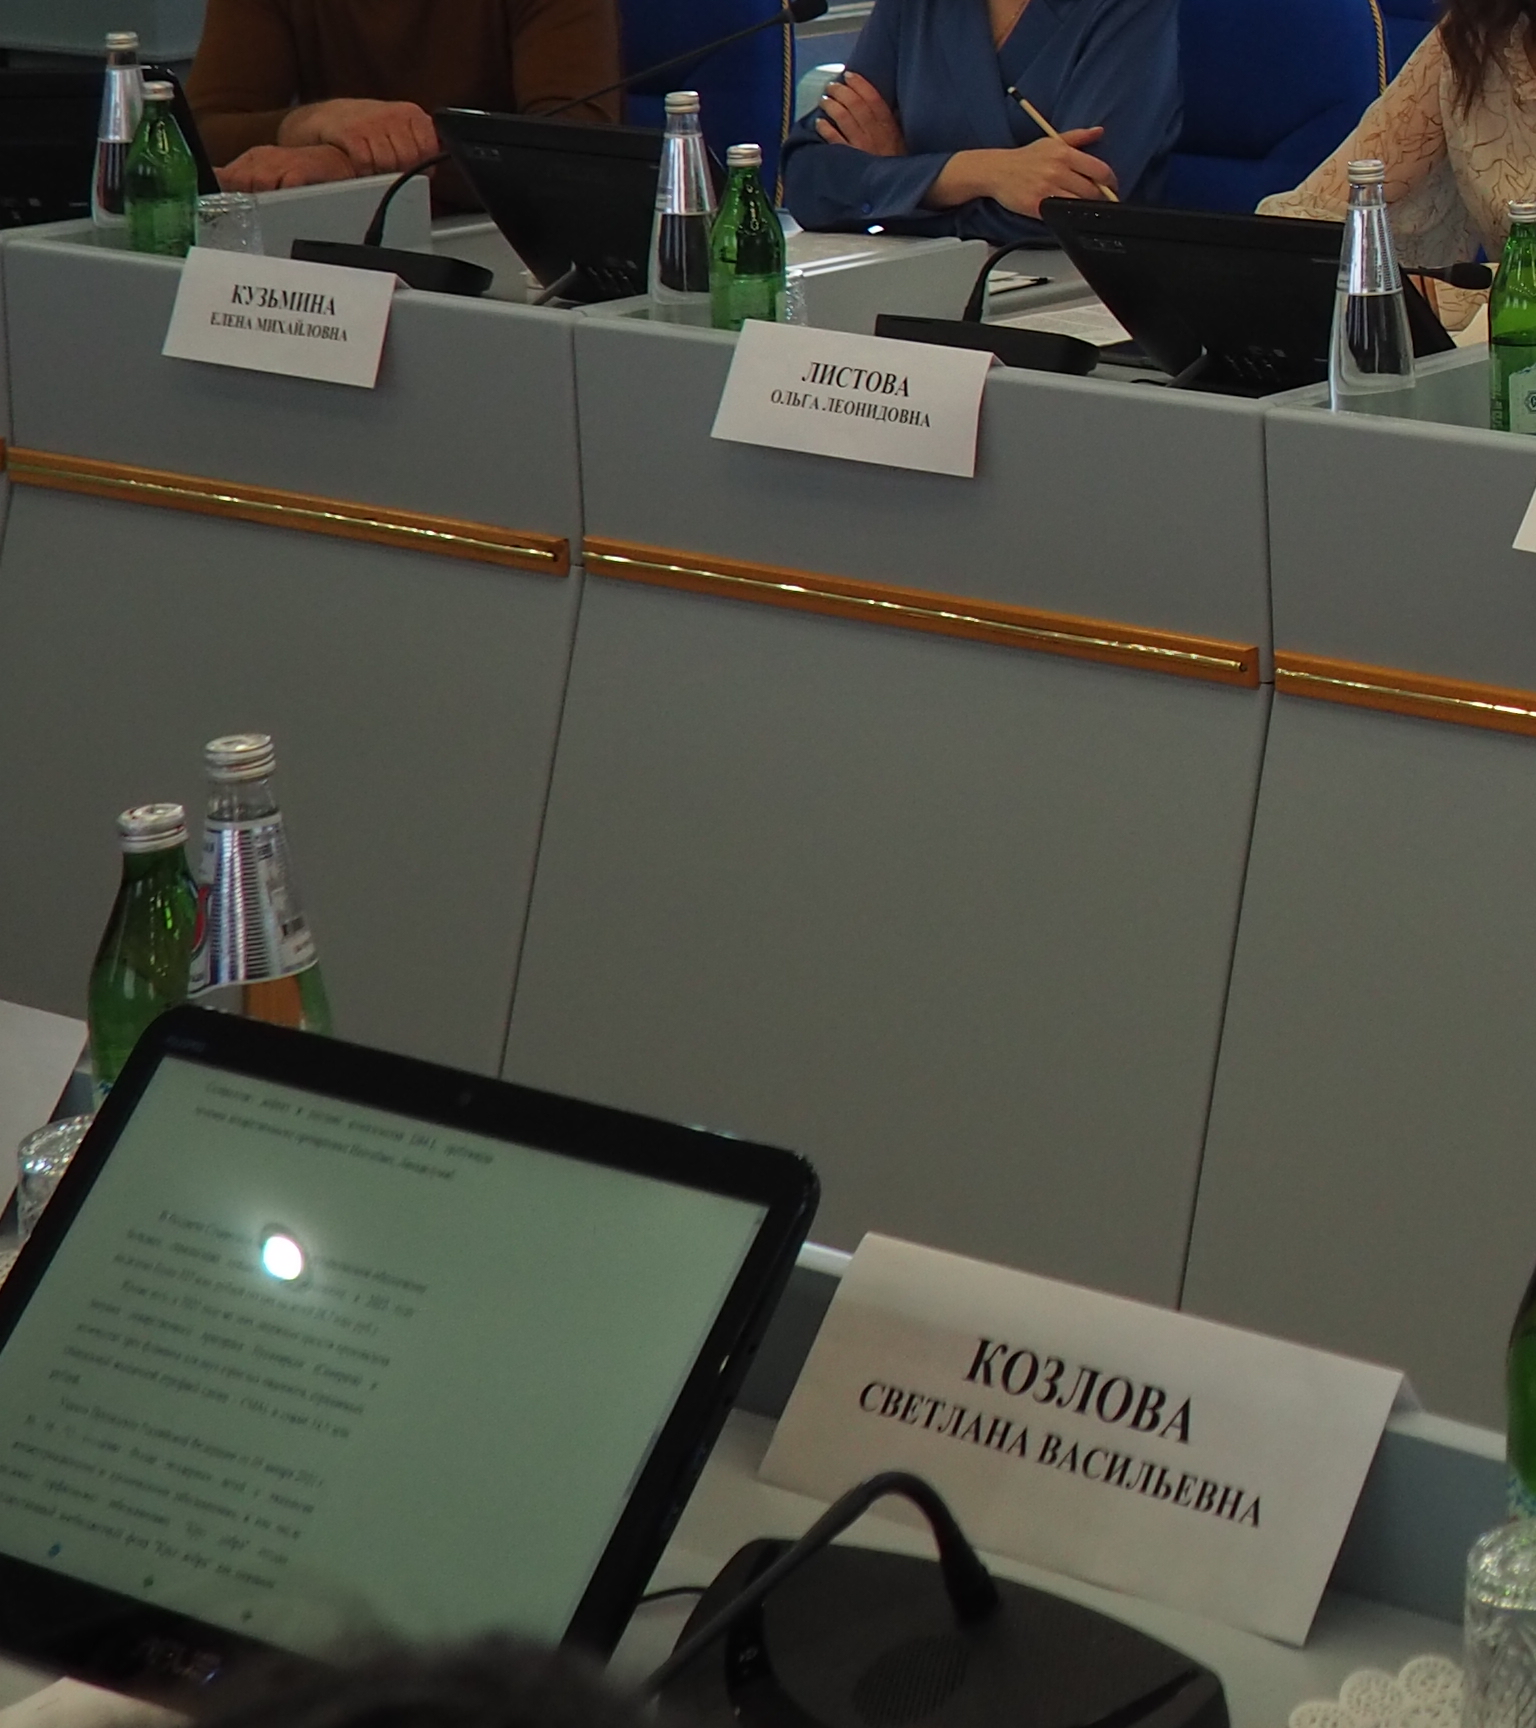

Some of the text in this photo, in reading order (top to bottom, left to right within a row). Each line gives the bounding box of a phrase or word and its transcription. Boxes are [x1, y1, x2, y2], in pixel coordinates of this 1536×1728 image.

[232, 284, 336, 315] КУЗЬМИНА
[210, 312, 347, 341] ЕЛЕНА МИХАЙЛОВНА
[802, 361, 909, 396] ЛИСТОВА
[771, 389, 931, 427] ОЛЬГА ЛЕОНИДОВНА
[964, 1337, 1194, 1445] КОЗЛОВА
[858, 1380, 1262, 1529] СВЕТЛАНА ВАСИЛЬЕВНА
